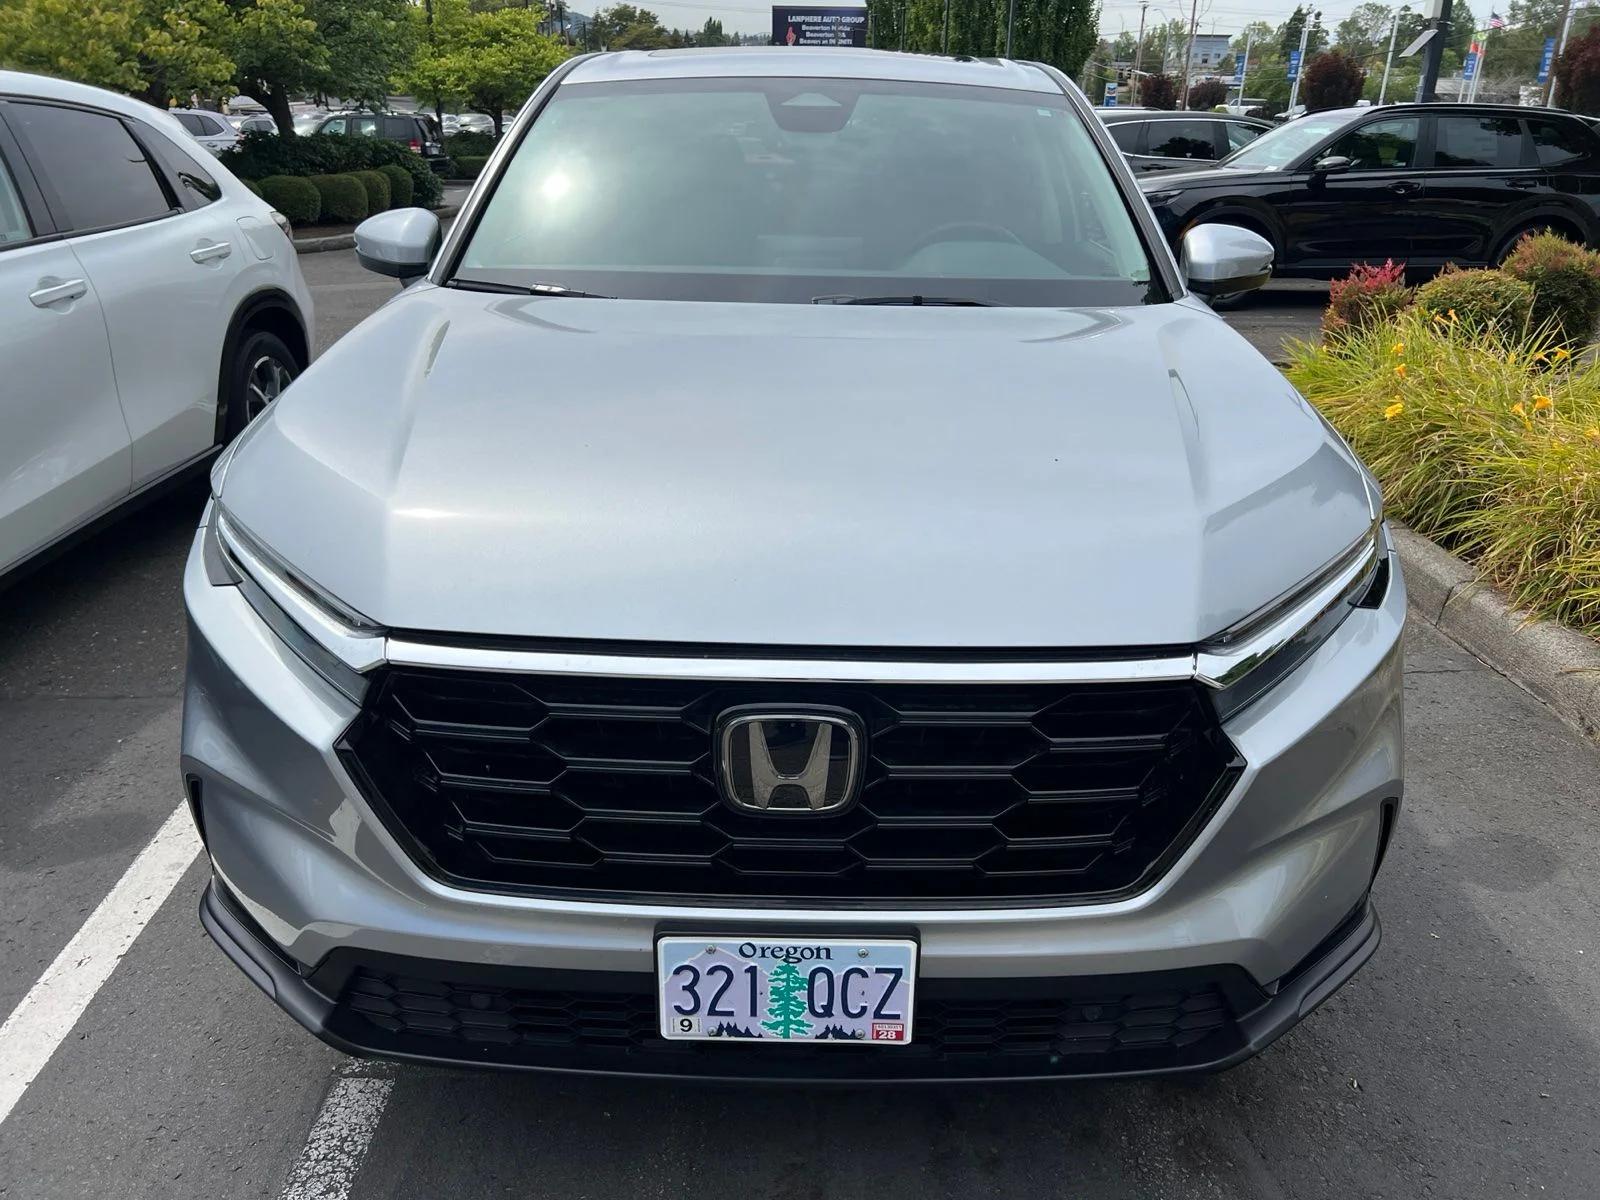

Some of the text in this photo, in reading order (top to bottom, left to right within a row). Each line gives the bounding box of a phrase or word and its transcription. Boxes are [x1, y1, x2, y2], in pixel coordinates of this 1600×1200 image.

[738, 942, 833, 964] Oregon
[672, 964, 904, 1020] 321 QCZ
[680, 1018, 693, 1032] 9
[879, 1030, 897, 1040] 28
